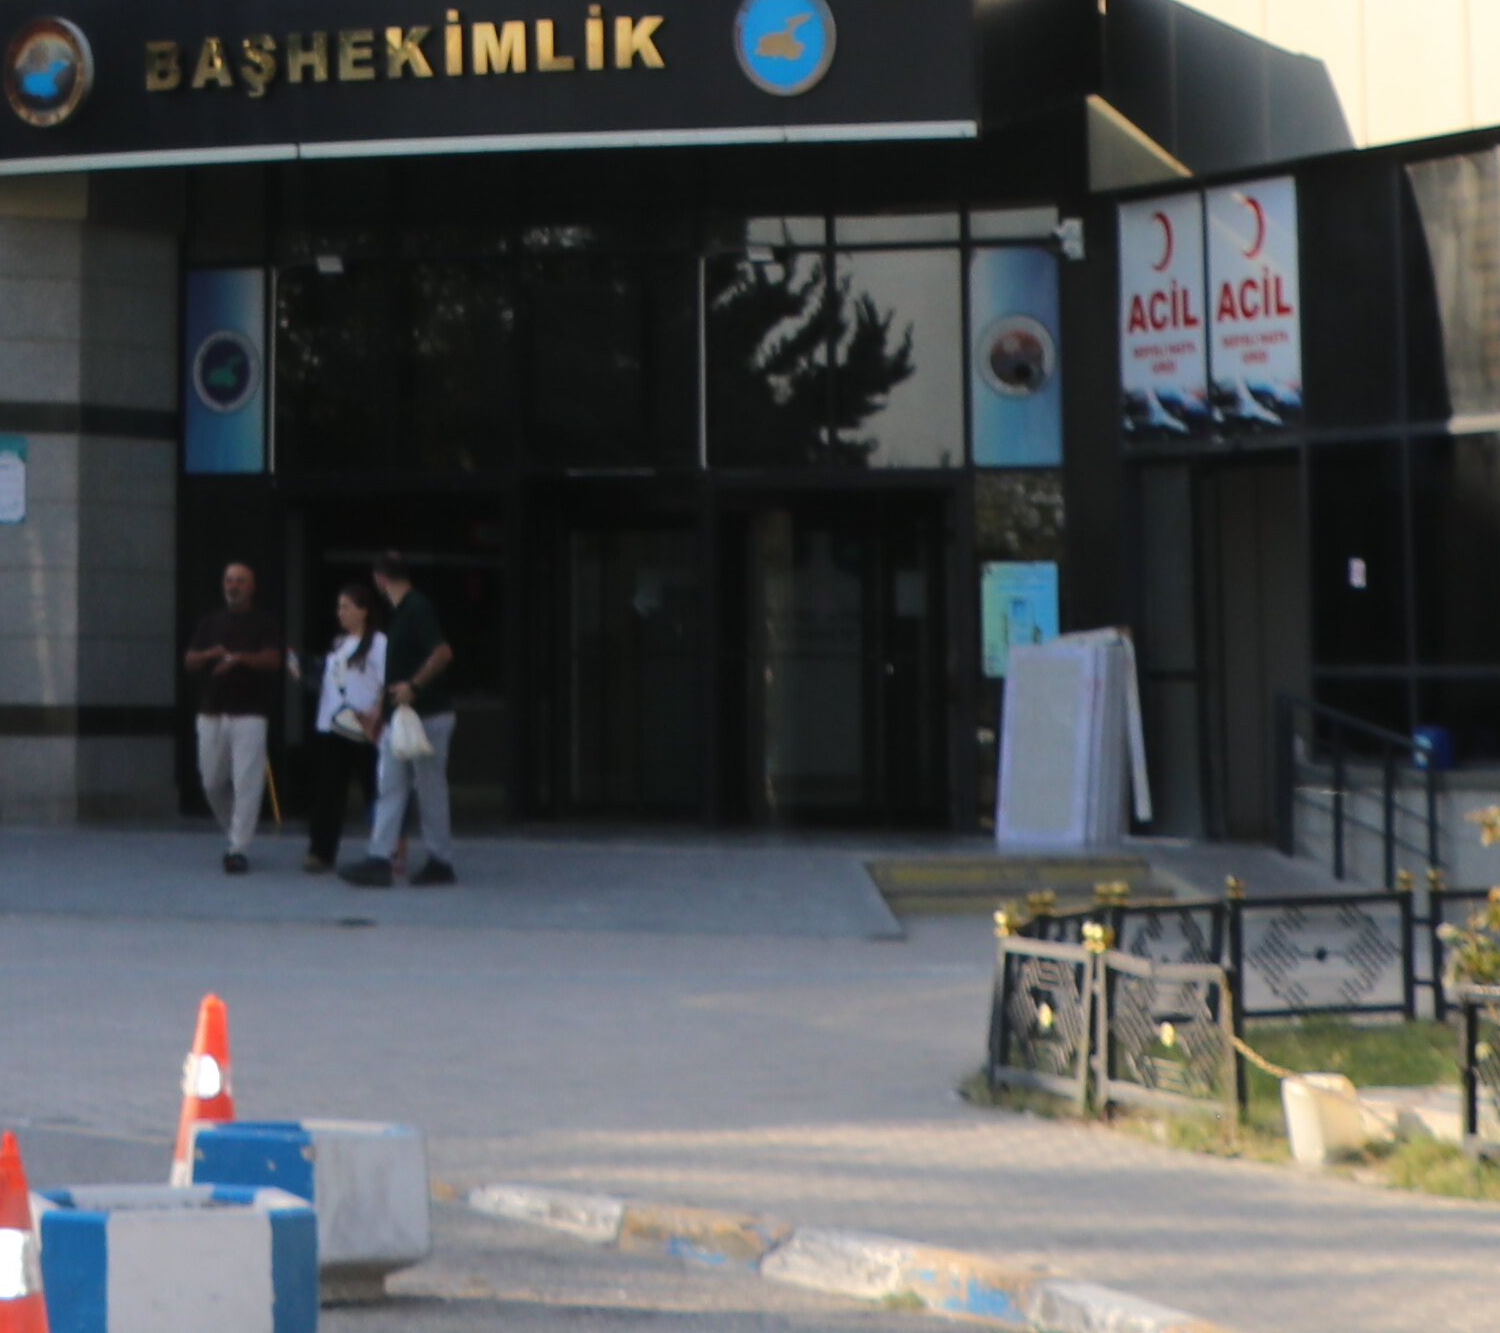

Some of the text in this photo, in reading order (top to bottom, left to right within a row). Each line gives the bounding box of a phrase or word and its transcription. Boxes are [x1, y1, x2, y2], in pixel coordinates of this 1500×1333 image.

[145, 2, 667, 98] BAŞHEKİMLİK
[1128, 278, 1200, 334] ACİL
[1217, 266, 1293, 321] ACİL
